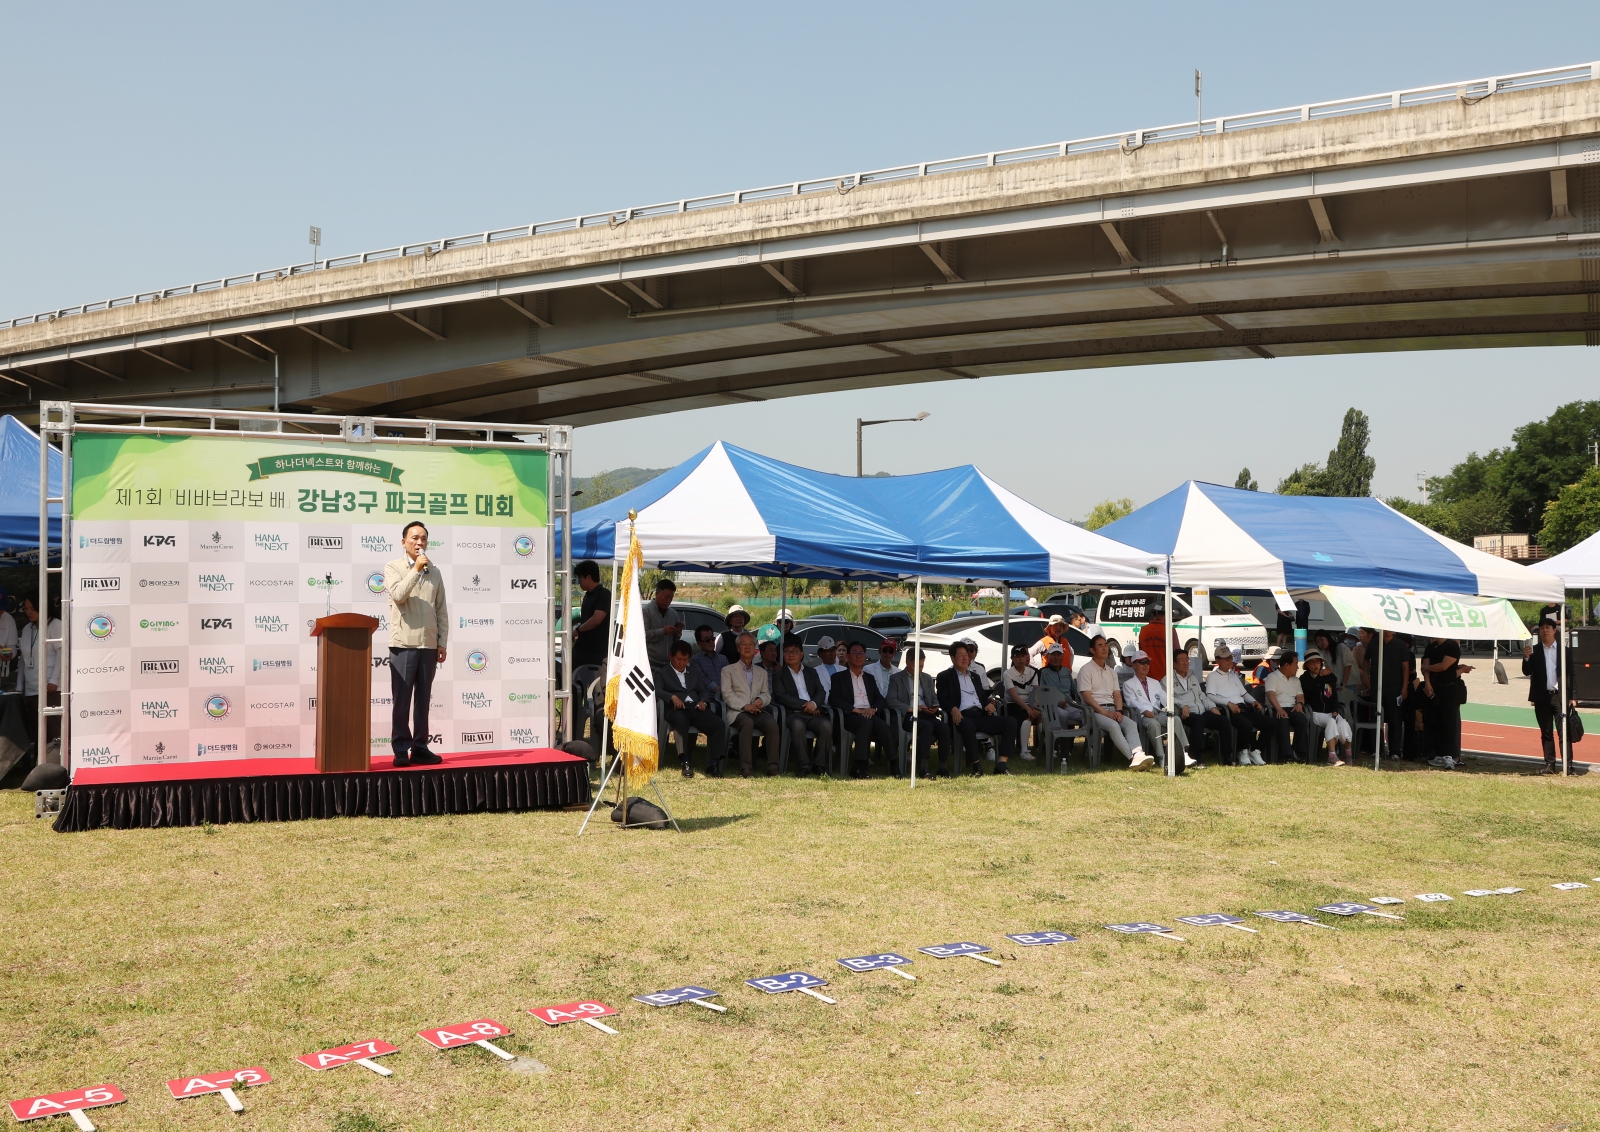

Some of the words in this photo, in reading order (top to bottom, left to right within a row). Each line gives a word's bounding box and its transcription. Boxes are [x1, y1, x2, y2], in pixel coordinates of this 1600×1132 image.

[275, 457, 344, 470] 하나더넥스트와
[346, 459, 382, 474] 함께하는
[115, 488, 162, 506] 제1회
[298, 489, 378, 514] 강남3구
[385, 491, 469, 516] 파크골프
[475, 494, 514, 517] 대회
[254, 533, 281, 543] HANA
[310, 538, 341, 546] BRAVO
[361, 535, 386, 544] HANA
[265, 542, 289, 551] NEXT
[370, 544, 393, 552] NEXT
[83, 579, 118, 588] BRAVO
[199, 574, 226, 583] HANA
[208, 583, 234, 592] NEXT
[1115, 606, 1146, 618] 더드림병원
[254, 615, 281, 624] HANA
[265, 623, 289, 632] NEXT
[143, 662, 177, 671] BRAVO
[199, 657, 226, 666] HANA
[76, 666, 125, 675] KOCOSTAR
[209, 665, 235, 674] NEXT
[462, 692, 485, 700] HANA
[141, 701, 170, 710] HANA
[470, 700, 492, 708] NEXT
[152, 709, 178, 719] NEXT
[463, 732, 493, 743] BRAVO
[510, 728, 533, 737] HANA
[518, 735, 540, 744] NEXT
[82, 747, 111, 757] HANA
[92, 755, 120, 765] NEXT
[1186, 913, 1233, 925] B-7
[1012, 930, 1069, 945] B-5
[925, 941, 982, 956] B-4
[845, 952, 904, 970] B-3
[755, 972, 819, 992] B-2
[649, 987, 706, 1004] B-1
[545, 1003, 606, 1021] A-9
[436, 1022, 501, 1045] A-8
[317, 1041, 378, 1067] A-7
[183, 1069, 262, 1093] A-6
[27, 1087, 113, 1115] A-5
